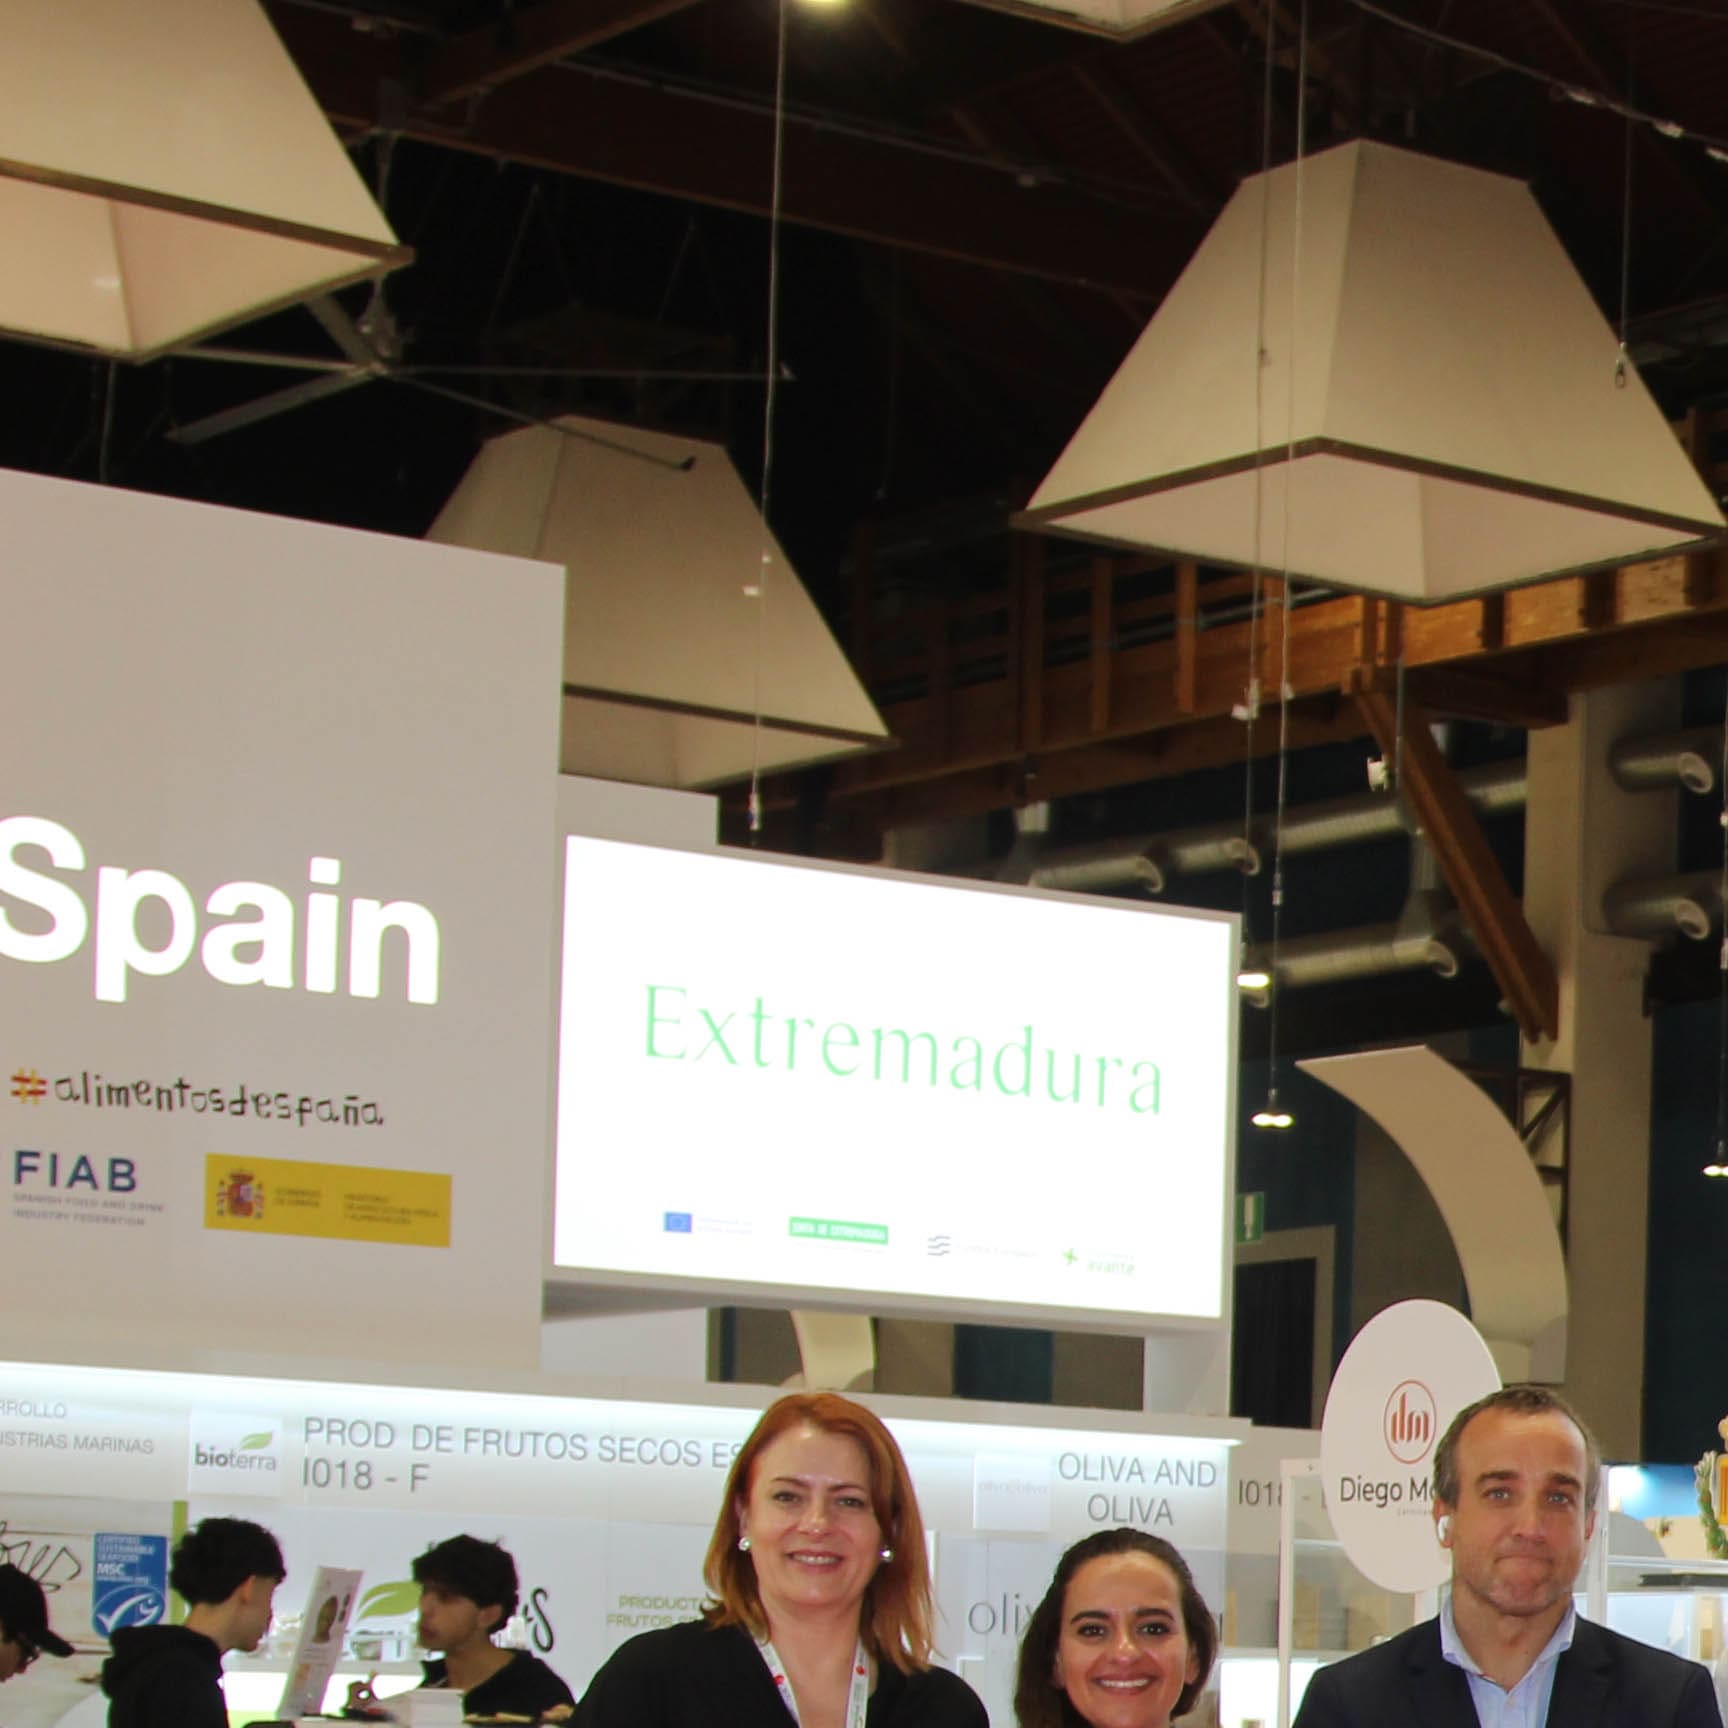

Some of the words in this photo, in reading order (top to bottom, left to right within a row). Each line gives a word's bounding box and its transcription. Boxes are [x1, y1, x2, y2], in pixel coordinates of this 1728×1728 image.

[0, 815, 440, 1004] Spain
[644, 984, 1162, 1115] Extremadura
[14, 1150, 138, 1192] FIAB
[73, 1433, 155, 1455] MARINAS
[194, 1442, 277, 1472] bioterra
[303, 1416, 396, 1450] PROD
[411, 1423, 454, 1454] DE
[464, 1427, 589, 1461] FRUTOS
[598, 1434, 702, 1468] SECOS
[409, 1463, 431, 1494] F
[1058, 1452, 1145, 1483] OLIVA
[1154, 1458, 1217, 1488] AND
[1340, 1475, 1402, 1508] Diego
[1087, 1493, 1173, 1526] OLIVA
[97, 1563, 126, 1576] MSC
